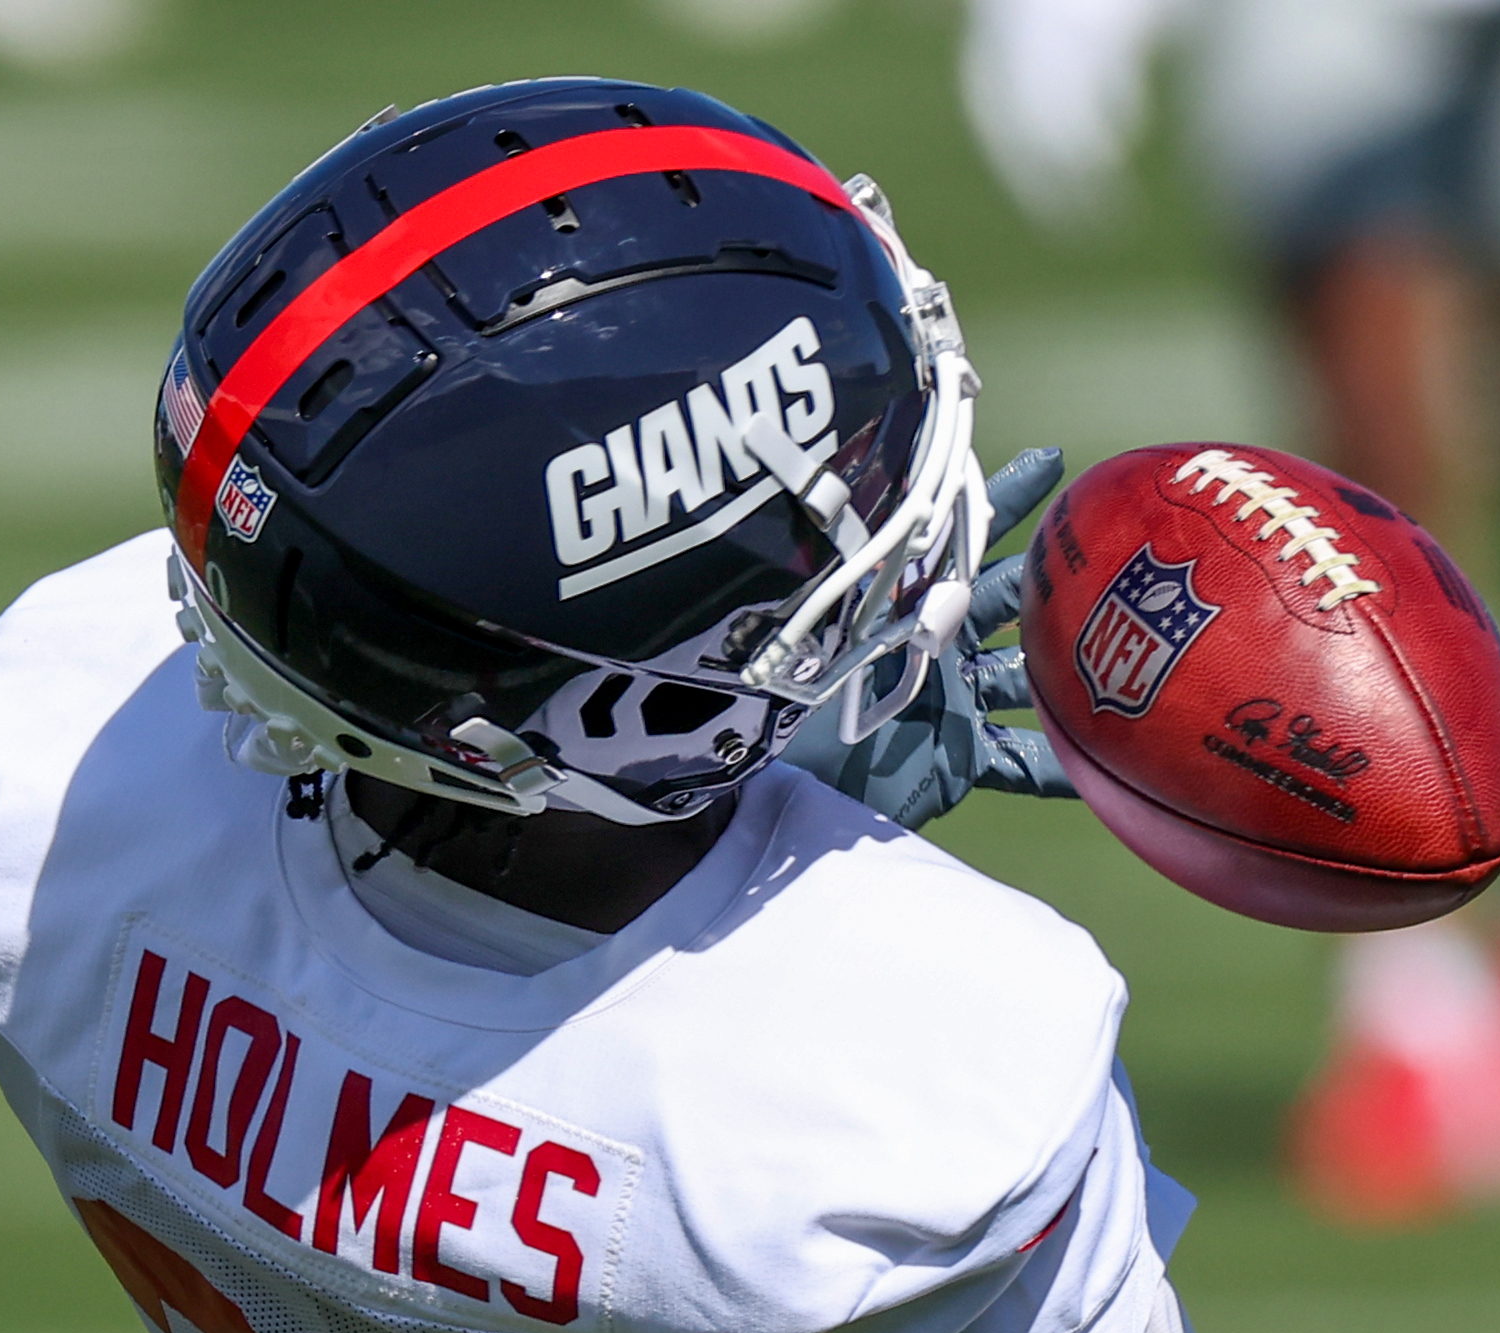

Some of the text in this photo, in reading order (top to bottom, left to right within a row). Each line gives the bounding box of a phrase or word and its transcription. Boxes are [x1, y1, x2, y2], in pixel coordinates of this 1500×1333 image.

[221, 483, 257, 534] NFL
[546, 316, 836, 566] GIANTS
[1081, 599, 1161, 701] NFL
[111, 948, 602, 1326] HOLMES
